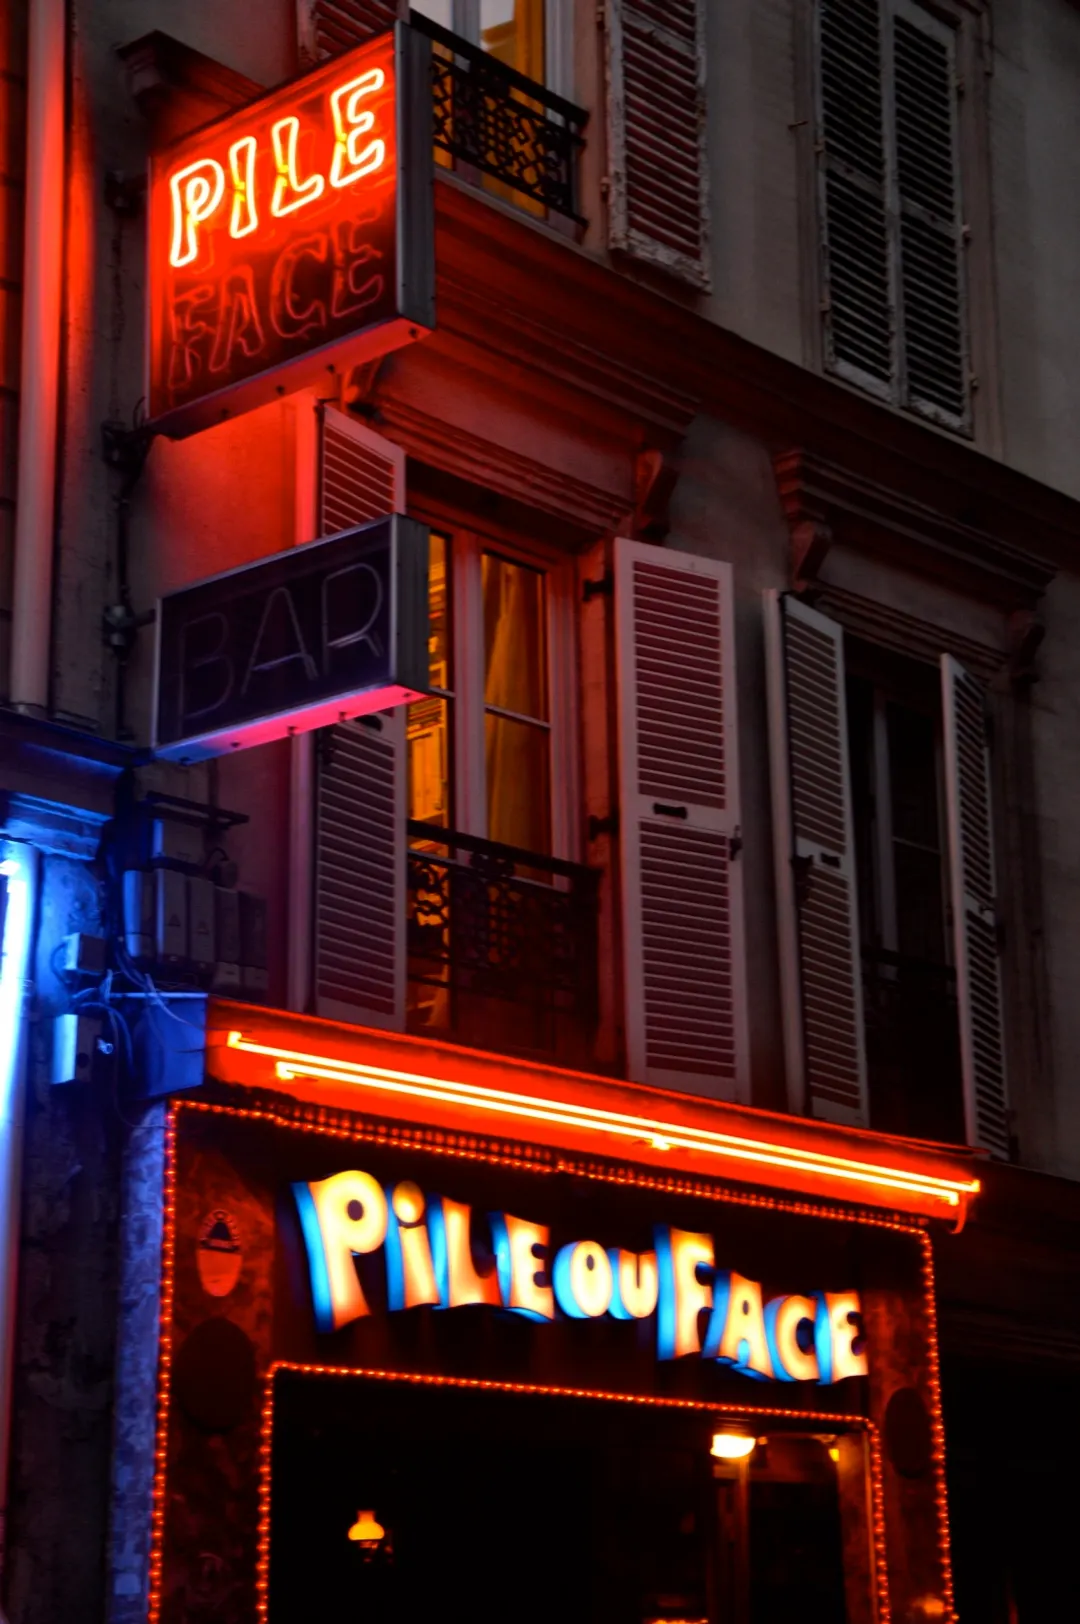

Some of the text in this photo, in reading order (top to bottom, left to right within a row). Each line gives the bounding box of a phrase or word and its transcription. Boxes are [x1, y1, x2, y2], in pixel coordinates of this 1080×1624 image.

[169, 67, 386, 268] PILE
[167, 211, 386, 390] FACE
[177, 561, 384, 738] BAR
[654, 1223, 869, 1386] FACE
